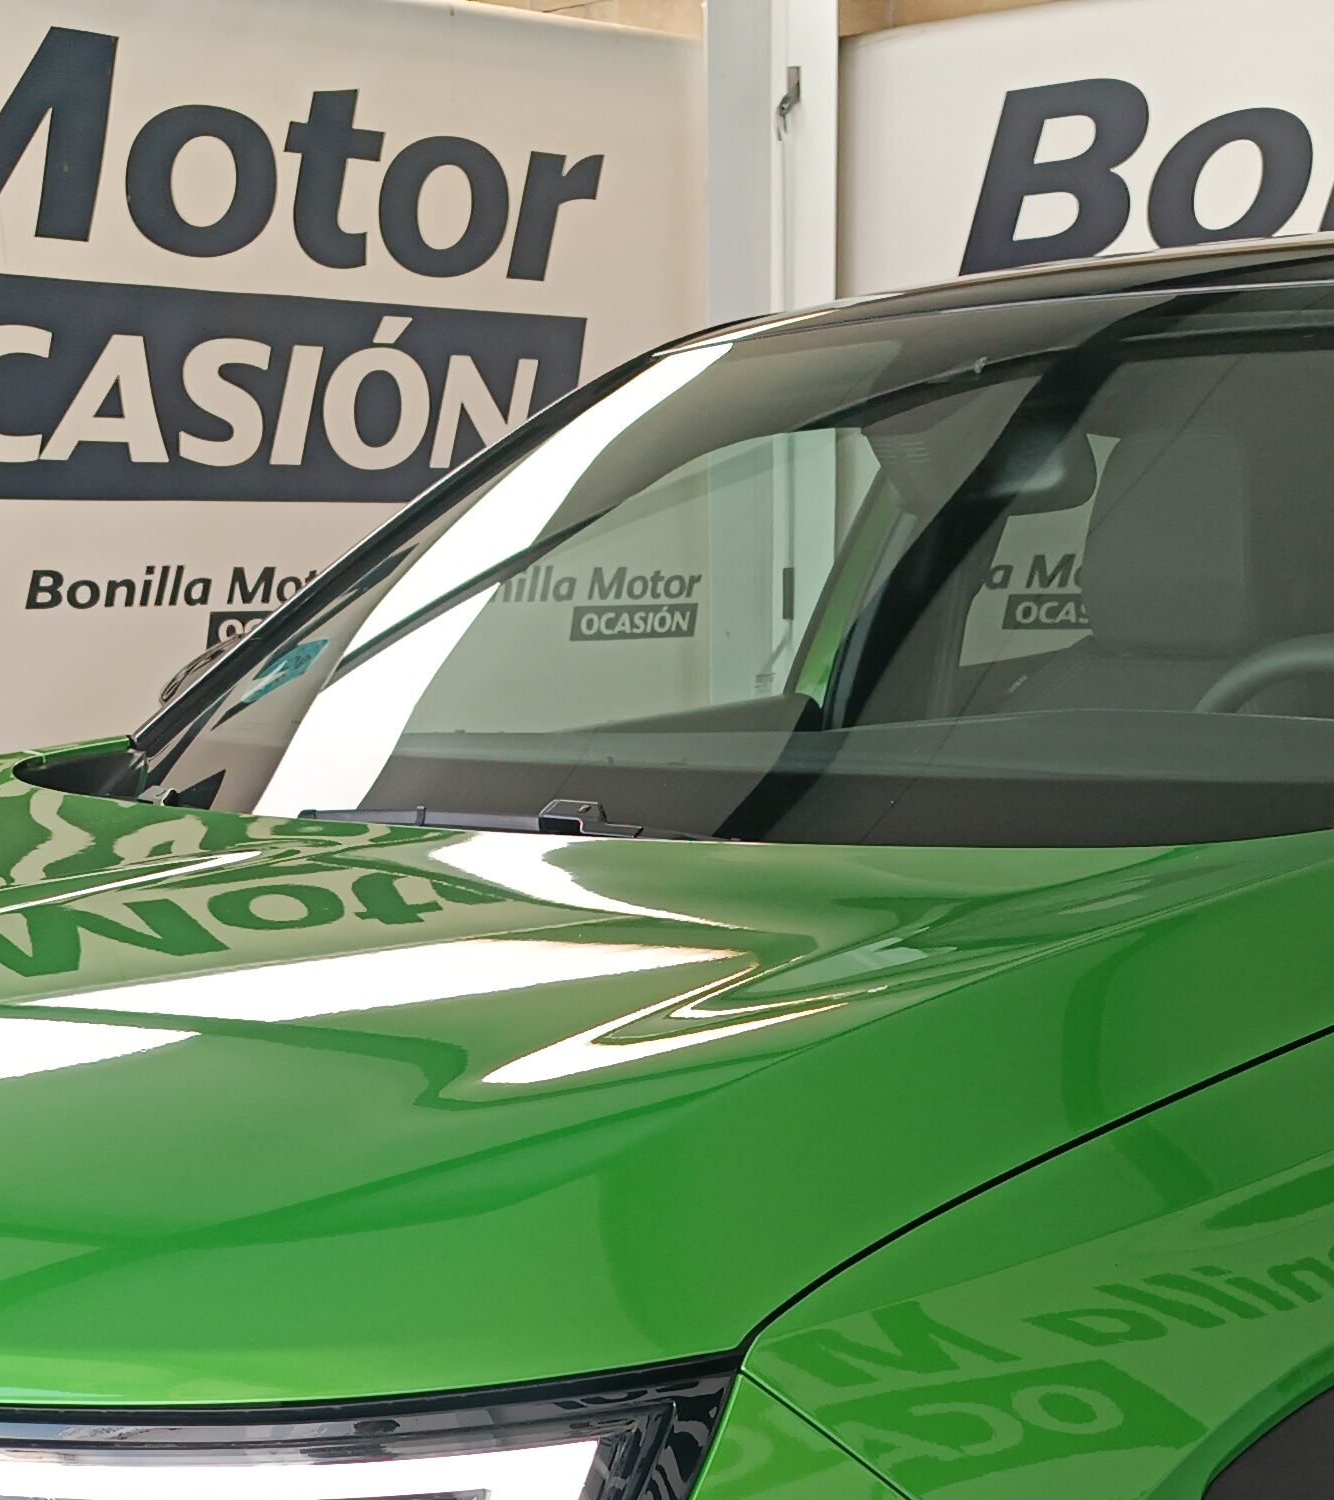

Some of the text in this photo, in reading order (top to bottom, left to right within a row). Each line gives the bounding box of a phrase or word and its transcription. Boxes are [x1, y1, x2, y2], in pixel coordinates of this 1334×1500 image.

[25, 565, 212, 609] Bonilla
[588, 567, 701, 600] Motor
[581, 606, 690, 635] OCASIÓN
